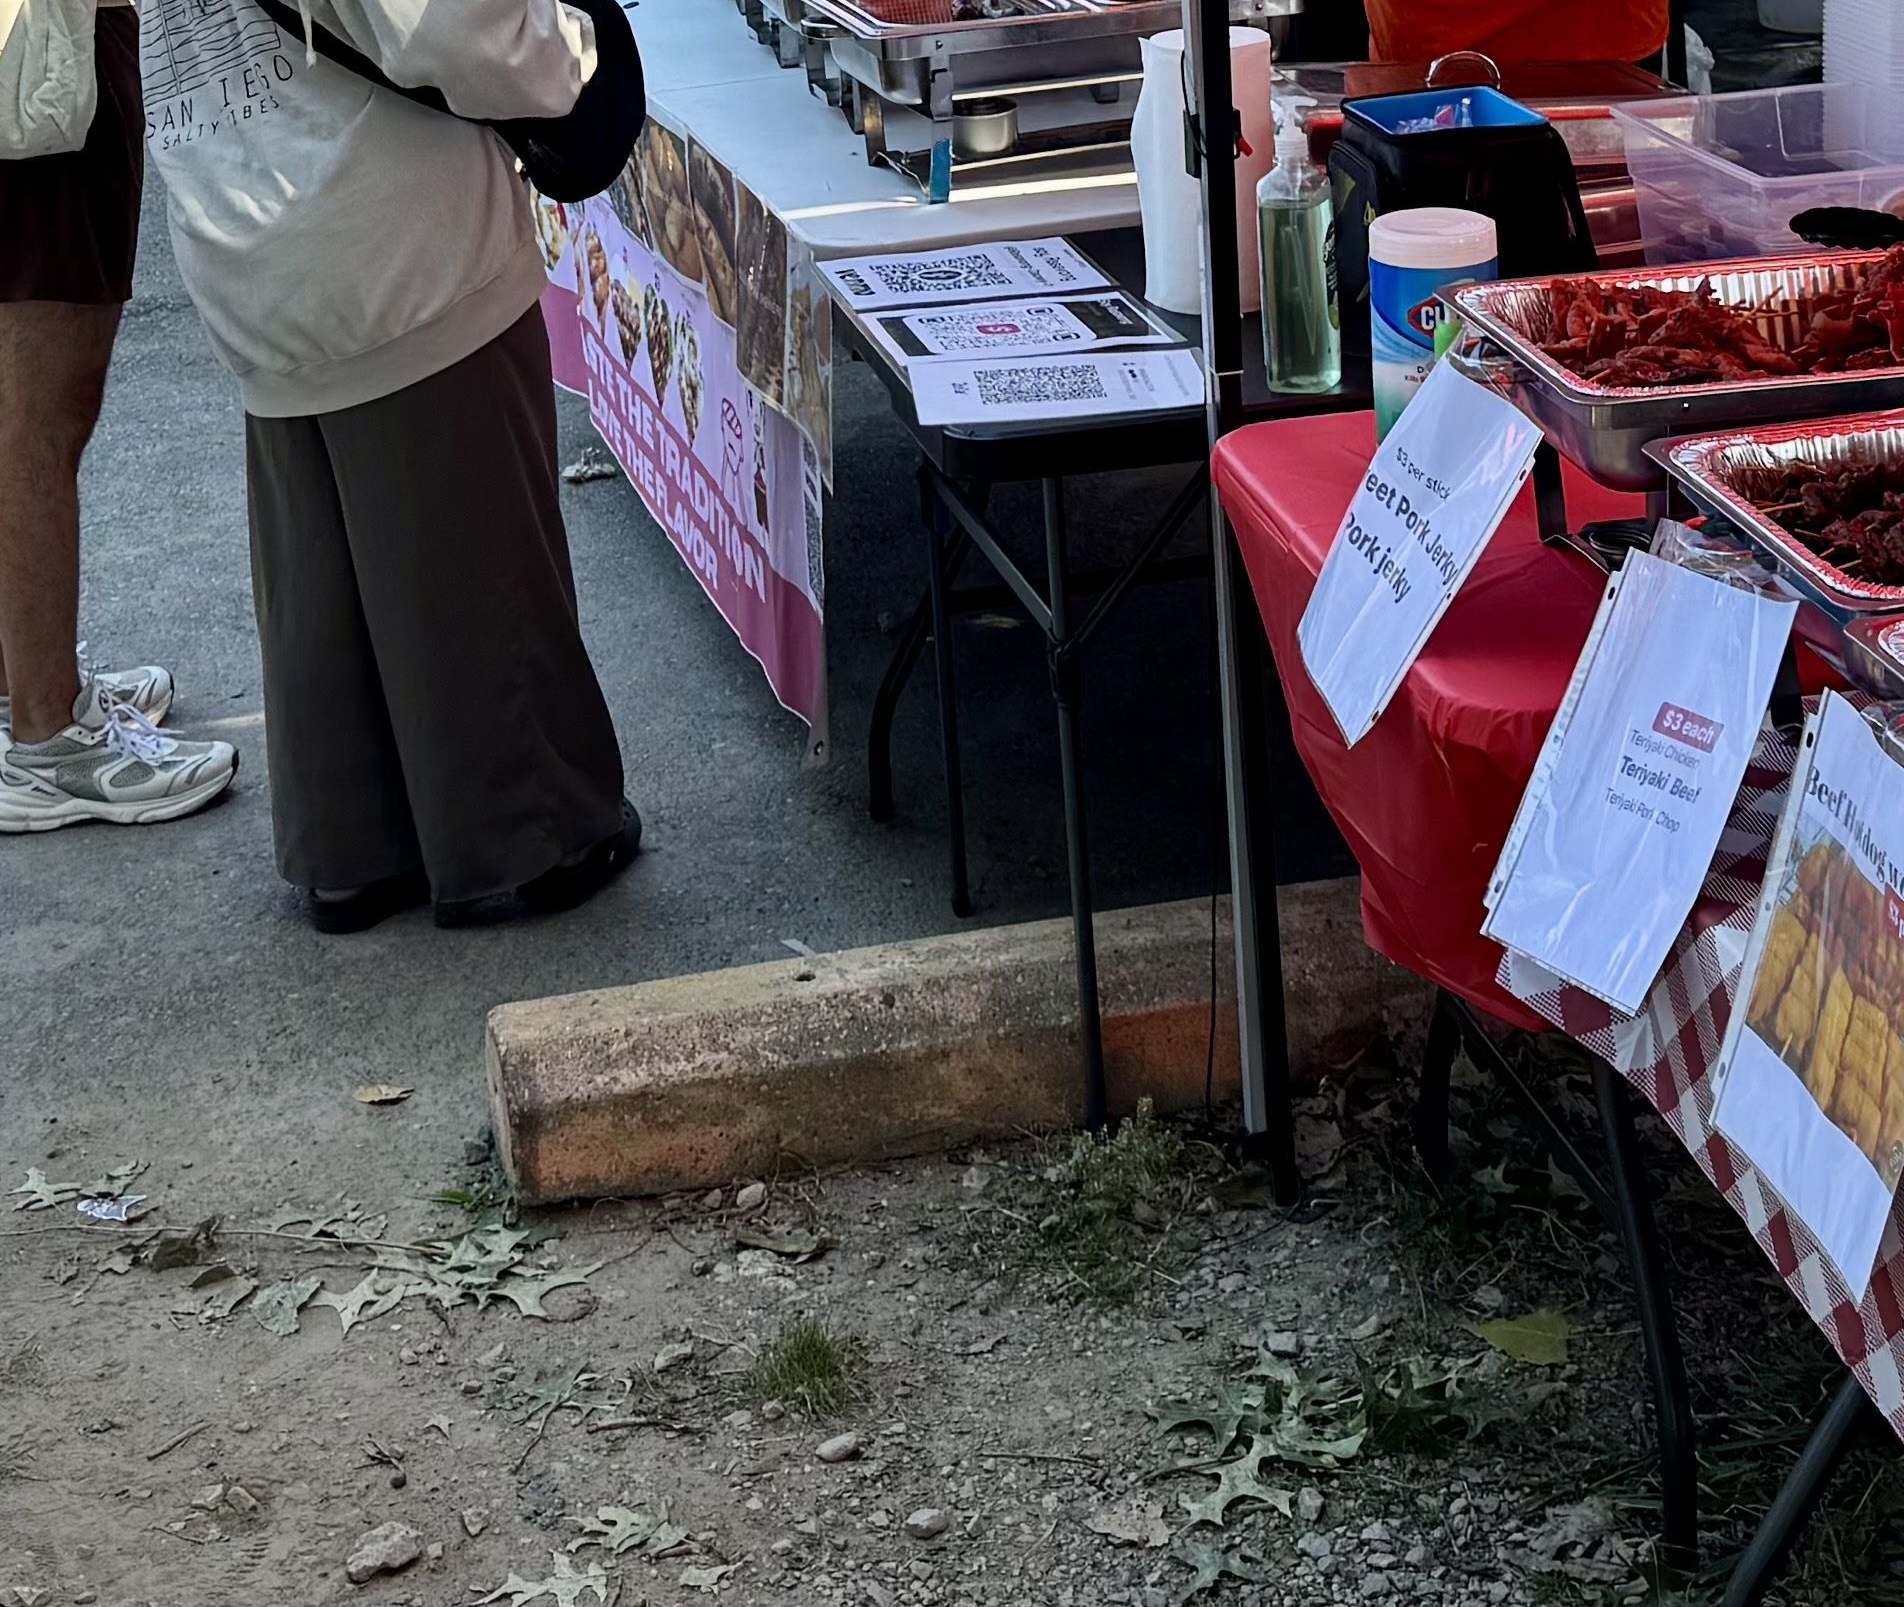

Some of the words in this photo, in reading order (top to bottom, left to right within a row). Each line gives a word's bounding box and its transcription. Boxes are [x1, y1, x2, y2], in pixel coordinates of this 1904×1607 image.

[146, 98, 193, 139] SAN
[218, 55, 293, 107] IEGO
[162, 121, 220, 150] SALTY
[226, 96, 280, 127] IBES
[616, 372, 655, 451] THE
[655, 417, 766, 604] TRADITION
[623, 426, 655, 498] THE
[656, 476, 718, 590] FLAVOR
[1365, 471, 1397, 510] eet
[1395, 495, 1431, 544] Pork
[1426, 534, 1458, 586] Jerky
[1373, 547, 1412, 603] jerky
[1663, 709, 1685, 731] $3
[1682, 719, 1715, 744] each
[1620, 755, 1672, 790] Teriyaki
[1669, 776, 1703, 804] Beef
[1807, 765, 1847, 819] Beef
